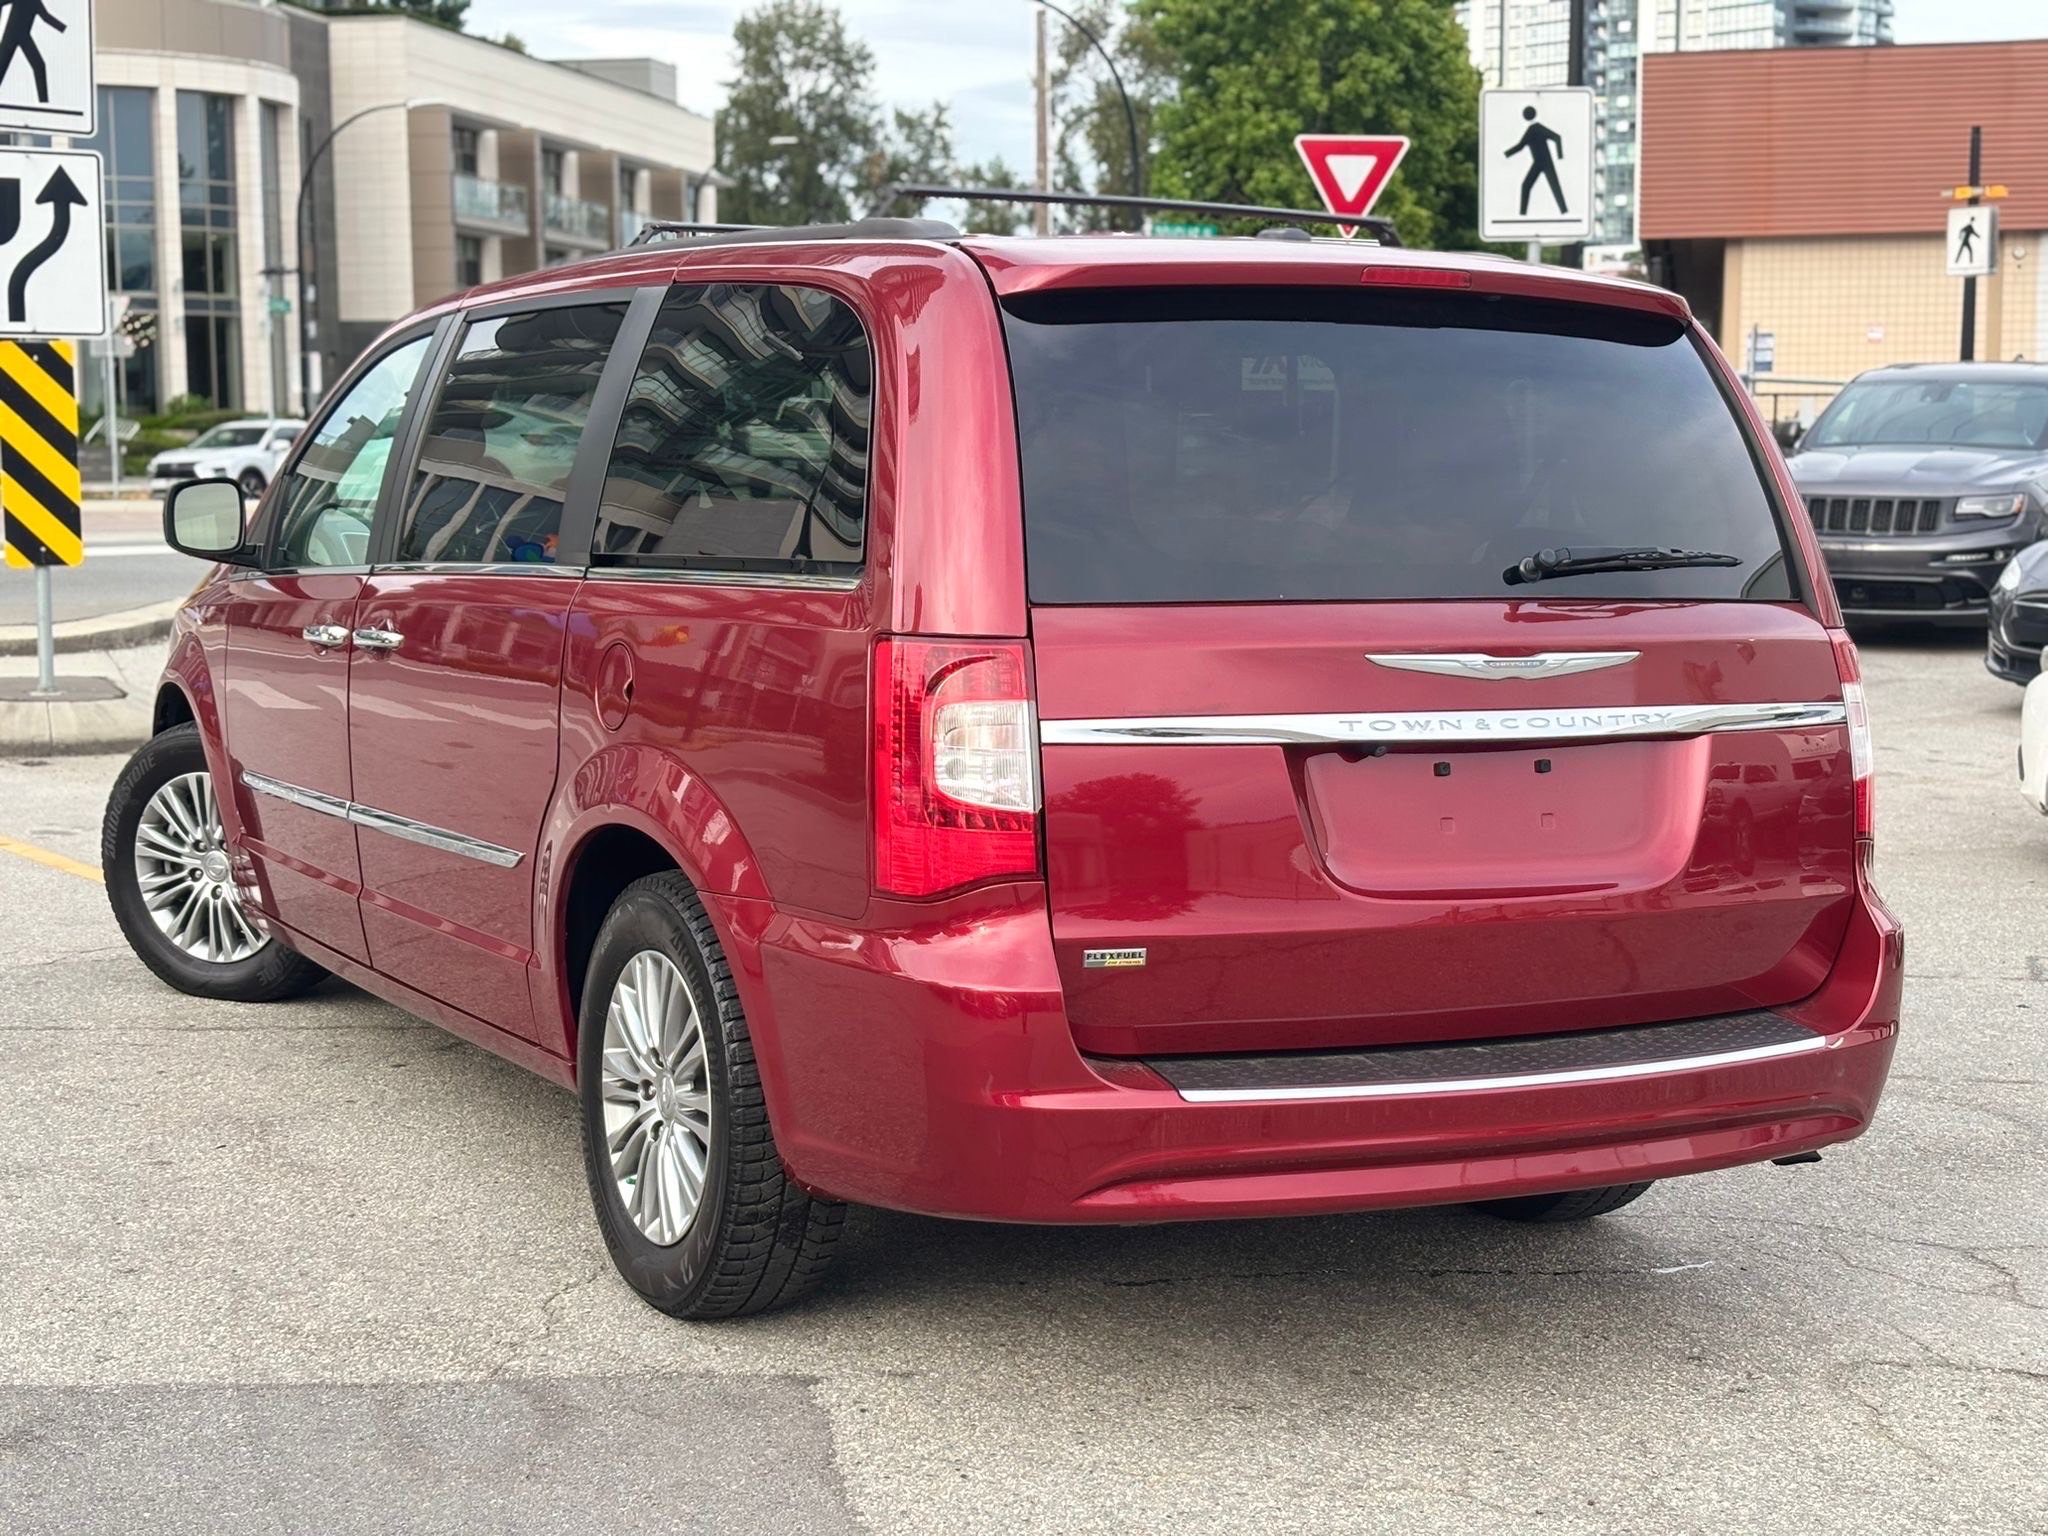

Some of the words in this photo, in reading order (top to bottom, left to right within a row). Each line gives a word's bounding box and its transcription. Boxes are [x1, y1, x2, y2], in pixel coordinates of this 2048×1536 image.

[1338, 718, 1464, 733] TOWN
[1475, 717, 1492, 731] &
[1499, 711, 1673, 730] COUNTRY
[105, 752, 157, 860] BRIDGESTONE
[1086, 952, 1144, 960] FLEXFUEL
